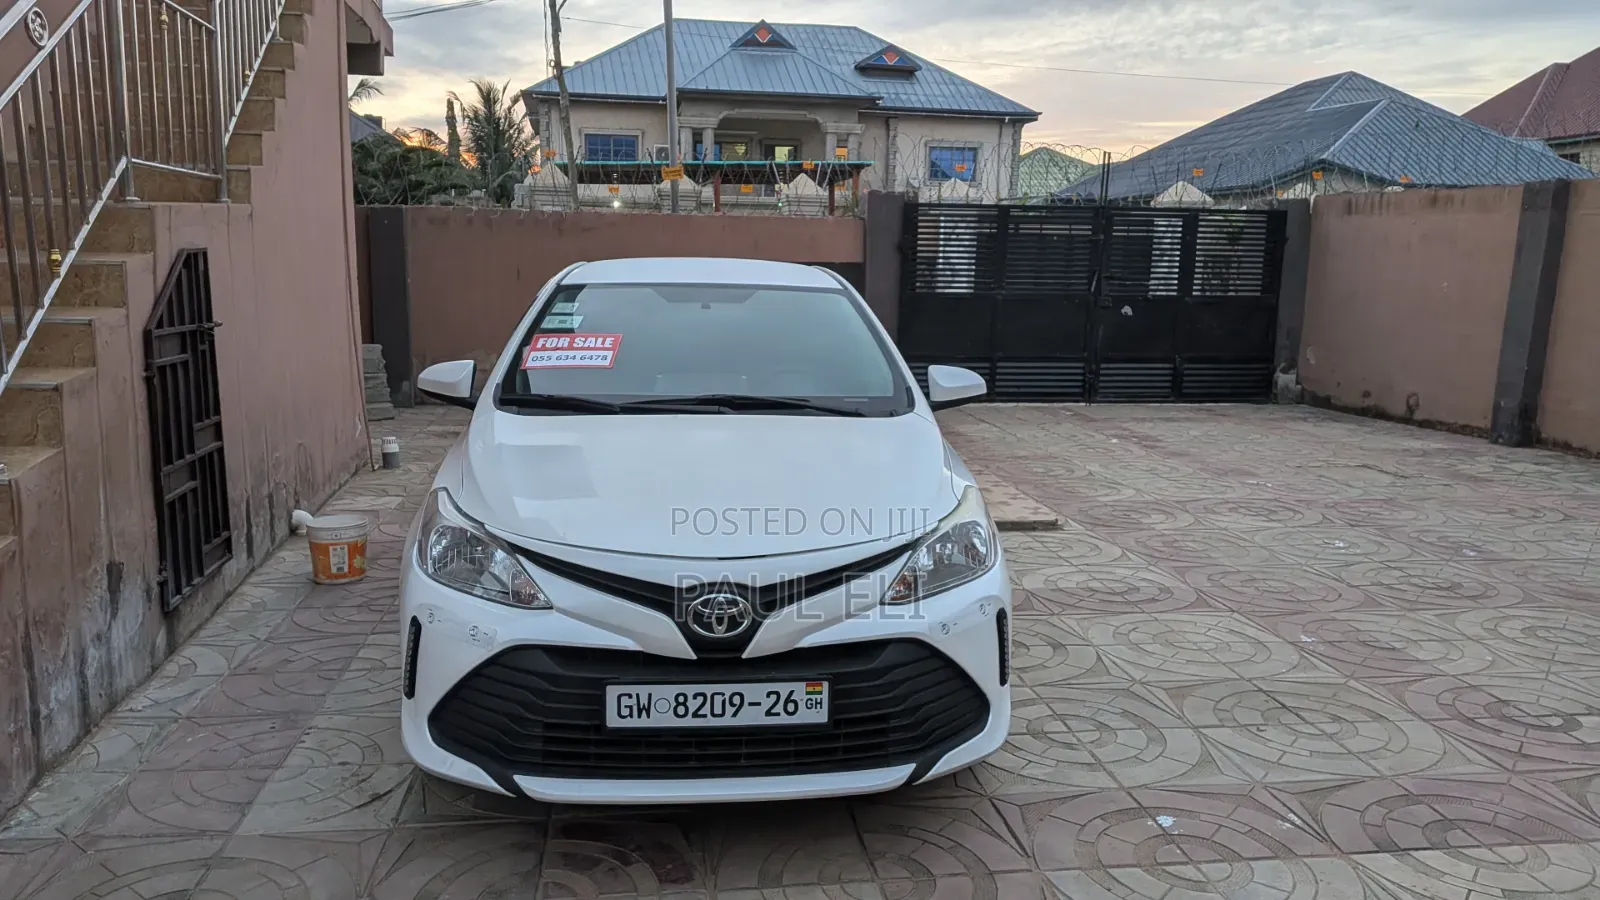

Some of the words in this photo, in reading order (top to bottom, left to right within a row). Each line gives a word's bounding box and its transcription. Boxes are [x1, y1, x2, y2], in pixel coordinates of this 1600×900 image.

[536, 337, 571, 348] FOR
[572, 337, 615, 348] SALE
[616, 692, 652, 719] GW
[673, 689, 799, 718] 8209-26
[805, 697, 823, 710] GH
